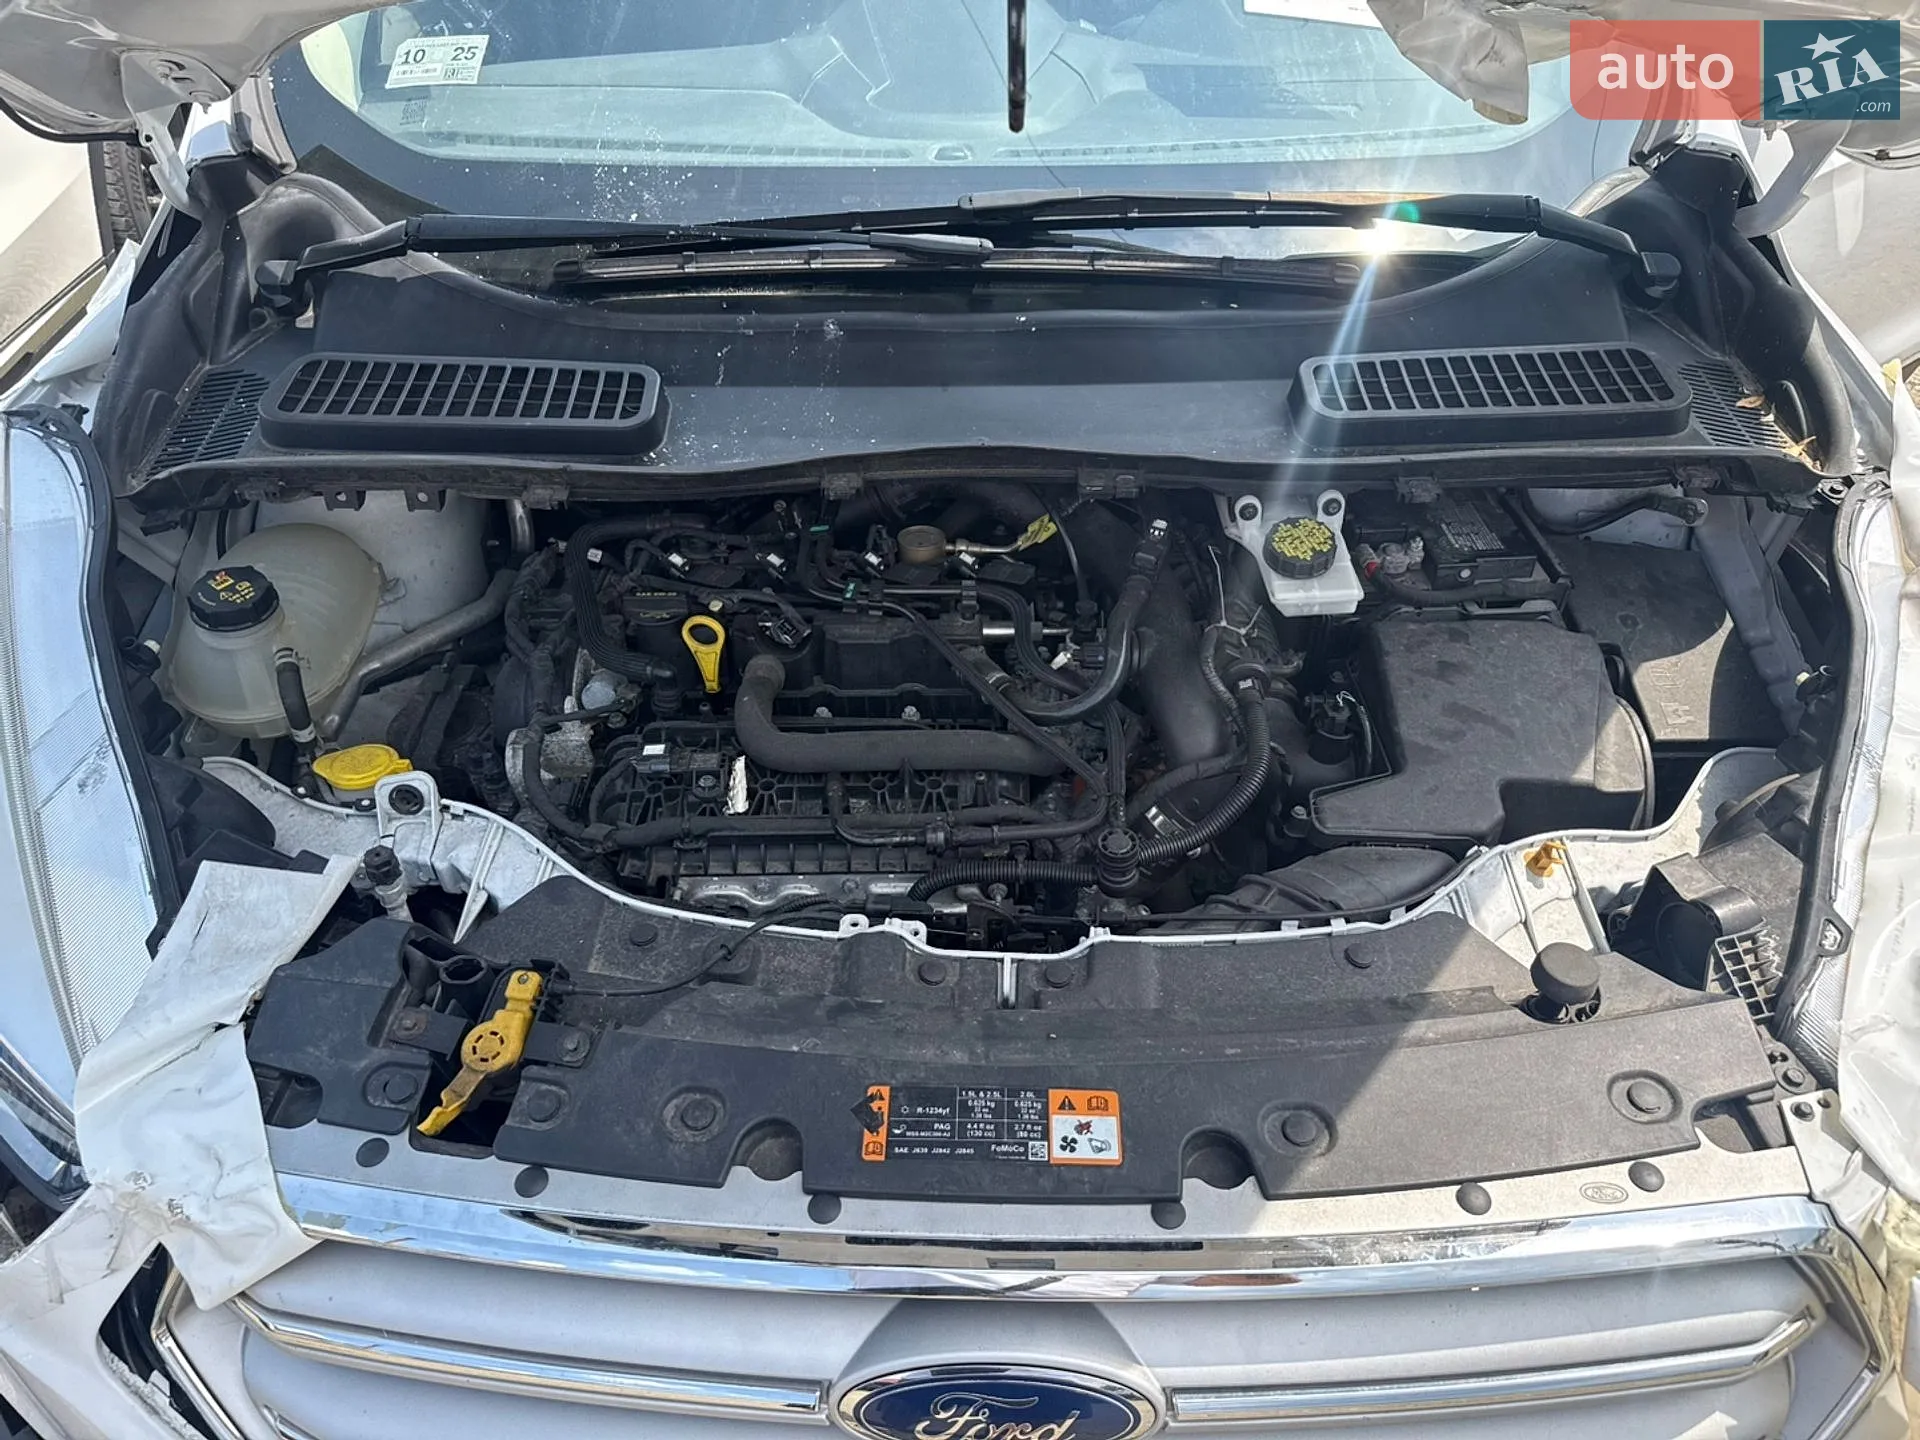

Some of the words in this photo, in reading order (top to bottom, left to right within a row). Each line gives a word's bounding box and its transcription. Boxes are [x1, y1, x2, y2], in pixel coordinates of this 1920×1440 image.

[401, 49, 426, 64] 10
[451, 46, 479, 61] 25
[987, 1100, 996, 1108] kg
[916, 1106, 950, 1116] R-1234yf
[933, 1122, 951, 1131] PAG
[990, 1143, 1026, 1153] FoMoCo
[914, 1391, 1081, 1440] Ford
